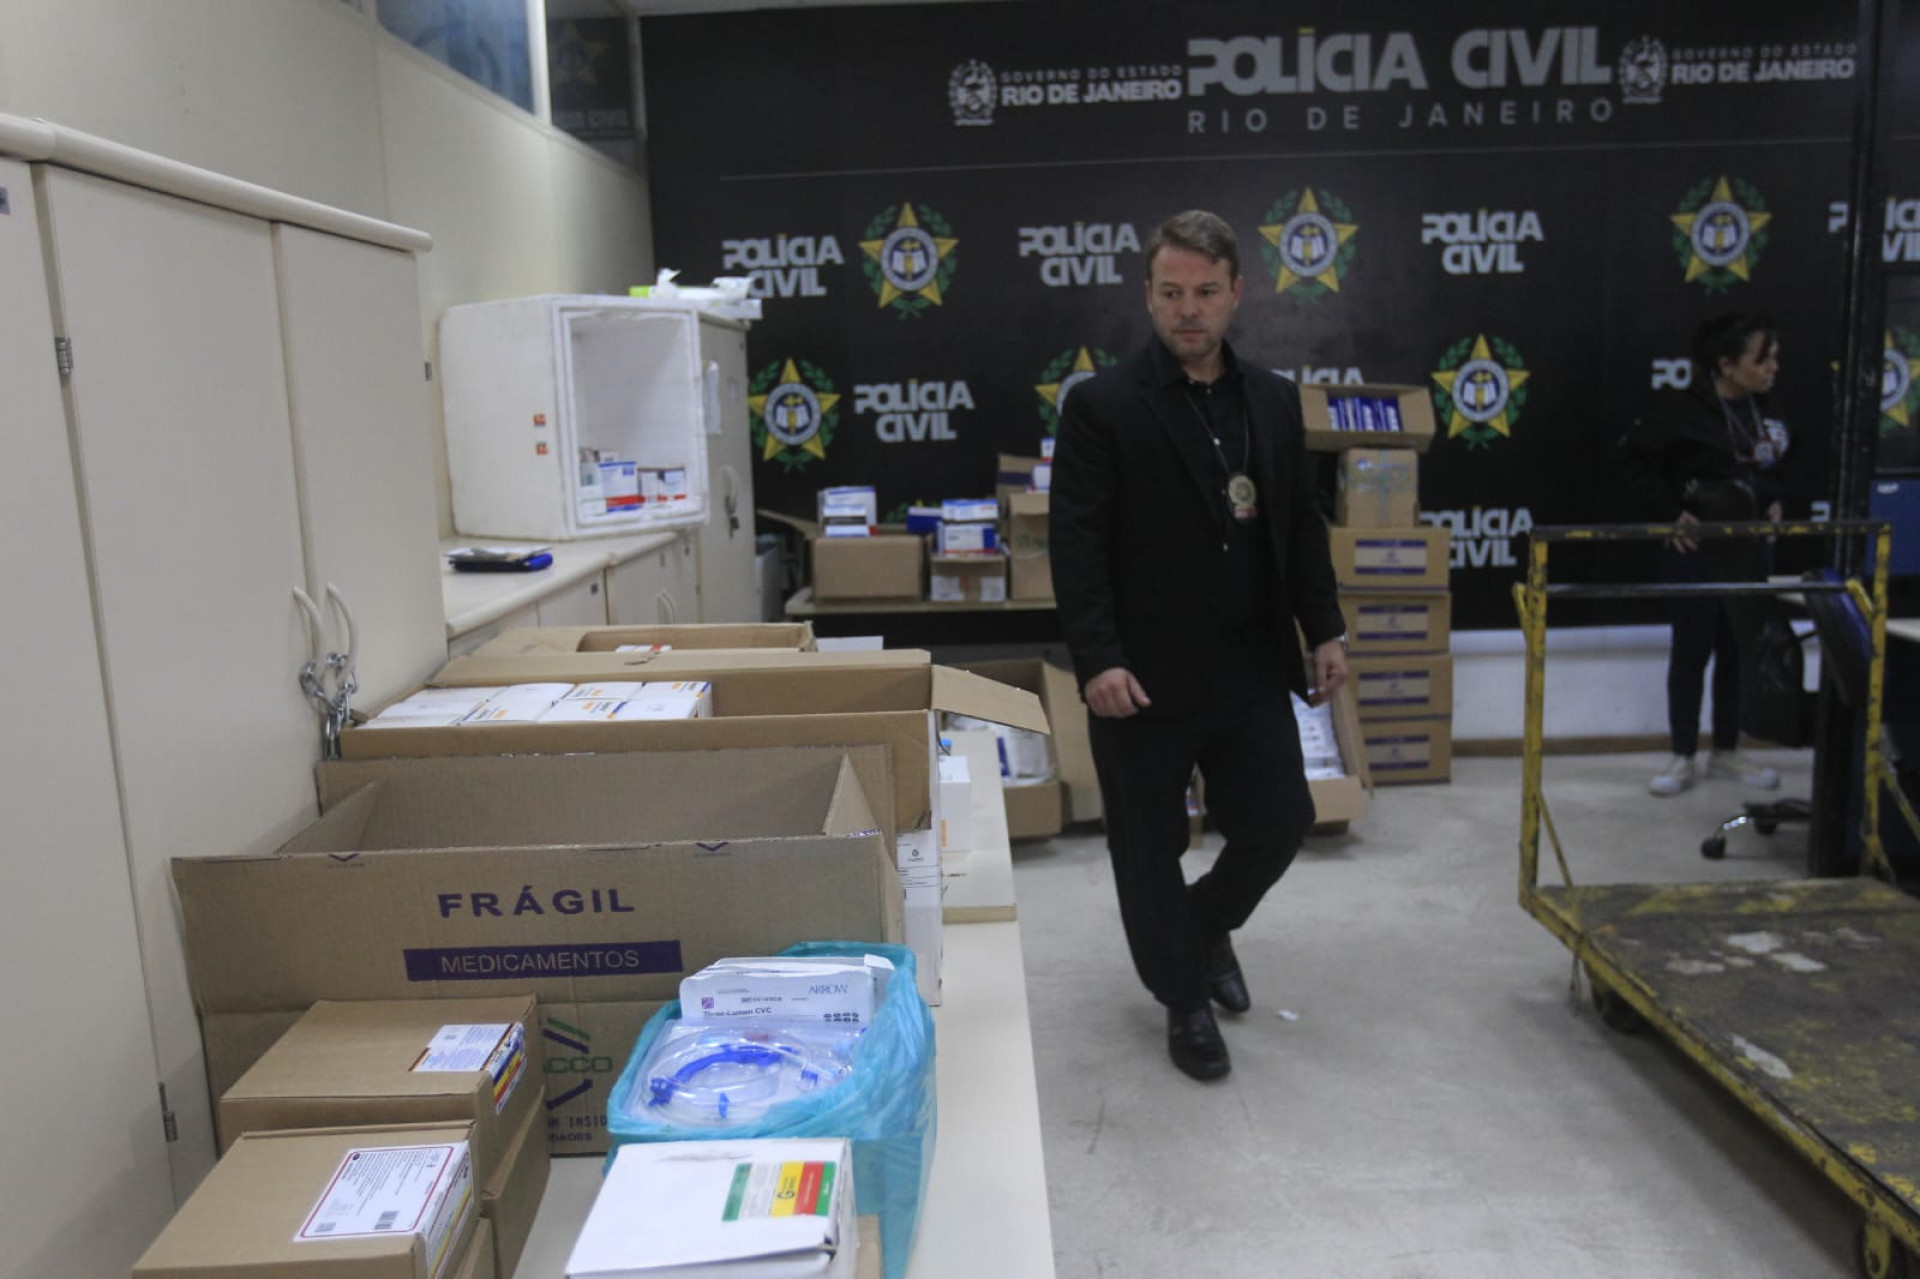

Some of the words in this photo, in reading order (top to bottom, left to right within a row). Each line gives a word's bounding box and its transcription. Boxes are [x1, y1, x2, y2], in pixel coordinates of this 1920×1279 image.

[1188, 27, 1428, 96] POLÍCIA
[1451, 26, 1613, 89] CIVIL
[1671, 47, 1753, 62] GOVERNO
[1760, 45, 1785, 59] DO
[1791, 43, 1858, 58] ESTADO
[1001, 70, 1081, 84] GOVERNO
[1087, 68, 1111, 80] DO
[1117, 65, 1183, 79] ESTADO
[1671, 63, 1714, 84] RIO
[1718, 62, 1750, 83] DE
[1754, 59, 1856, 82] JANEIRO
[1001, 86, 1044, 106] RIO
[1047, 84, 1079, 104] DE
[1083, 80, 1182, 104] JANEIRO
[1188, 108, 1268, 134] RIO
[1306, 104, 1361, 131] DE
[1397, 97, 1613, 129] JANEIRO
[1019, 221, 1142, 258] POLÍCIA
[1422, 208, 1544, 245] POLÍCIA
[721, 233, 845, 270] POLÍCIA
[1442, 243, 1524, 275] CIVIL
[1040, 256, 1123, 287] CIVIL
[853, 379, 975, 414] POLÍCIA
[875, 411, 957, 443] CIVIL
[437, 885, 635, 918] FRÁGIL
[441, 950, 640, 974] MEDICAMENTOS
[808, 984, 848, 995] ARROW
